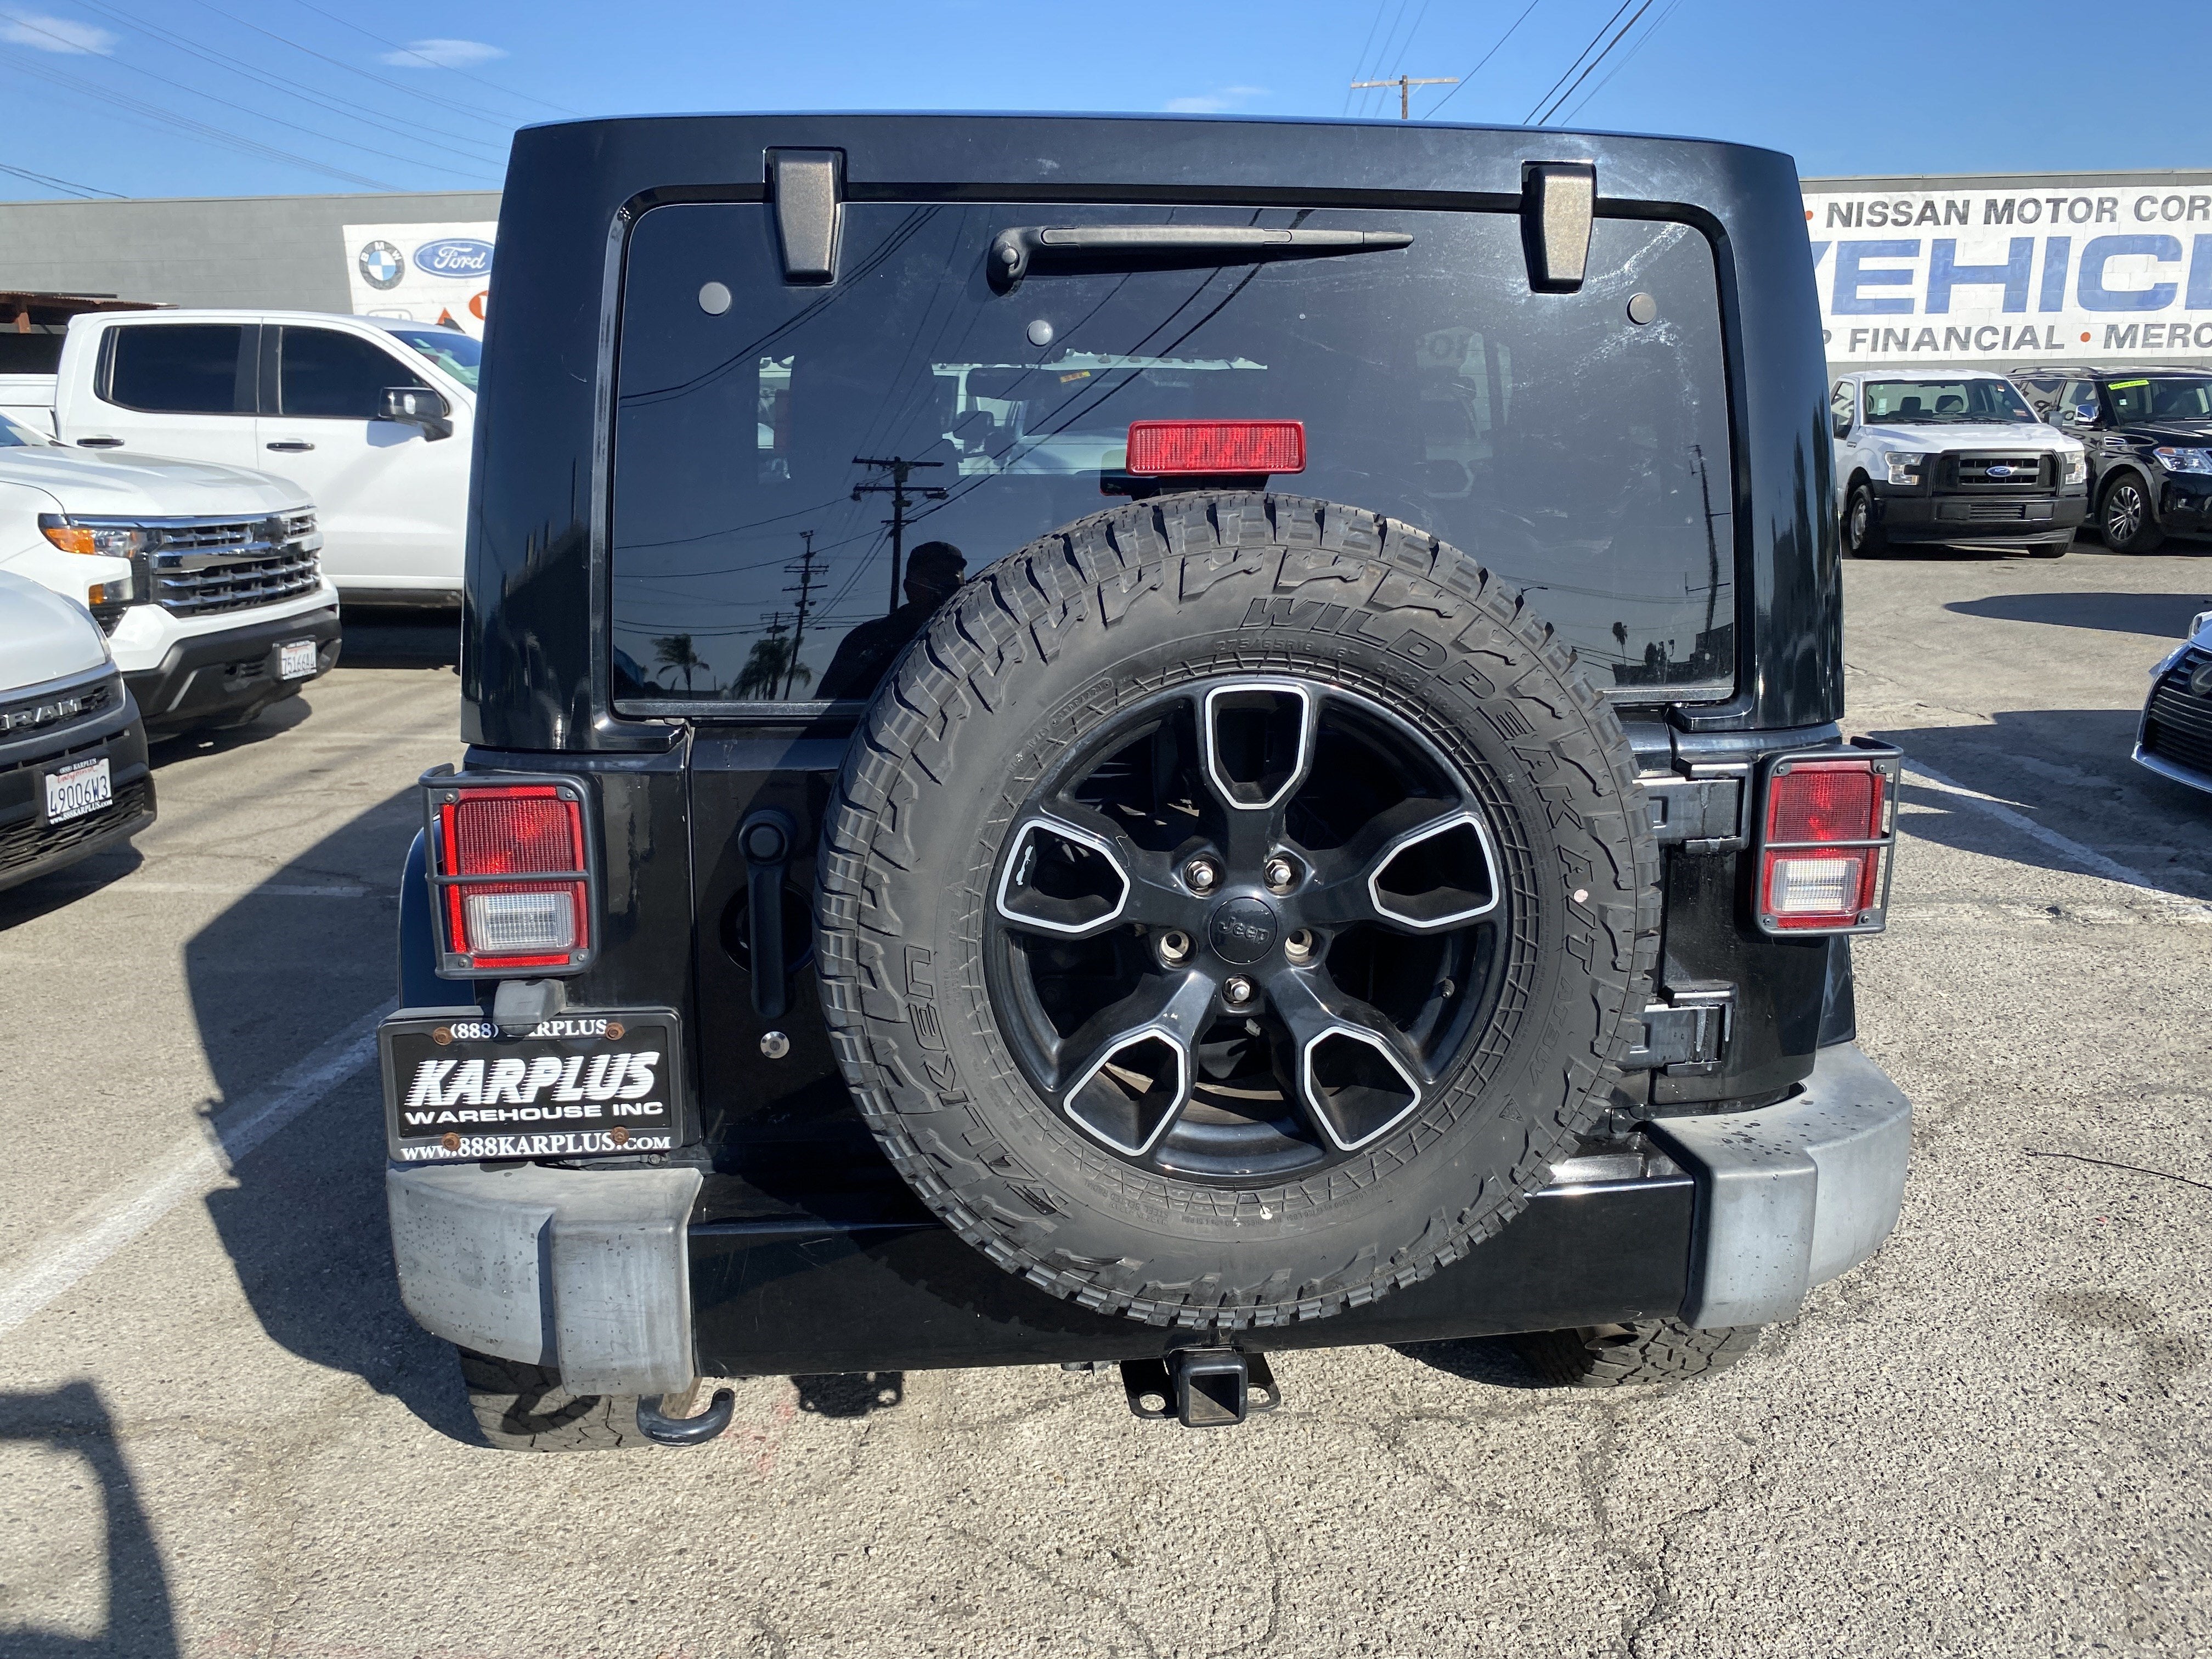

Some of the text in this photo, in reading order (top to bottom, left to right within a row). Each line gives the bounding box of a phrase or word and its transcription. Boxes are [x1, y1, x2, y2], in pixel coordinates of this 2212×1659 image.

[1826, 199, 1971, 228] NISSAN
[1983, 196, 2119, 225] MOTOR
[360, 241, 402, 262] BMW
[434, 246, 486, 269] Ford
[1848, 325, 2066, 353] FINANCIAL
[1, 699, 82, 730] RAM
[1238, 597, 1582, 830] WILDPEAK
[50, 775, 109, 814] 49006W3
[1218, 916, 1269, 945] Jeep
[450, 1022, 499, 1040] (888)
[404, 1051, 660, 1107] KARPLUS
[404, 1101, 664, 1125] WAREHOUSE INC
